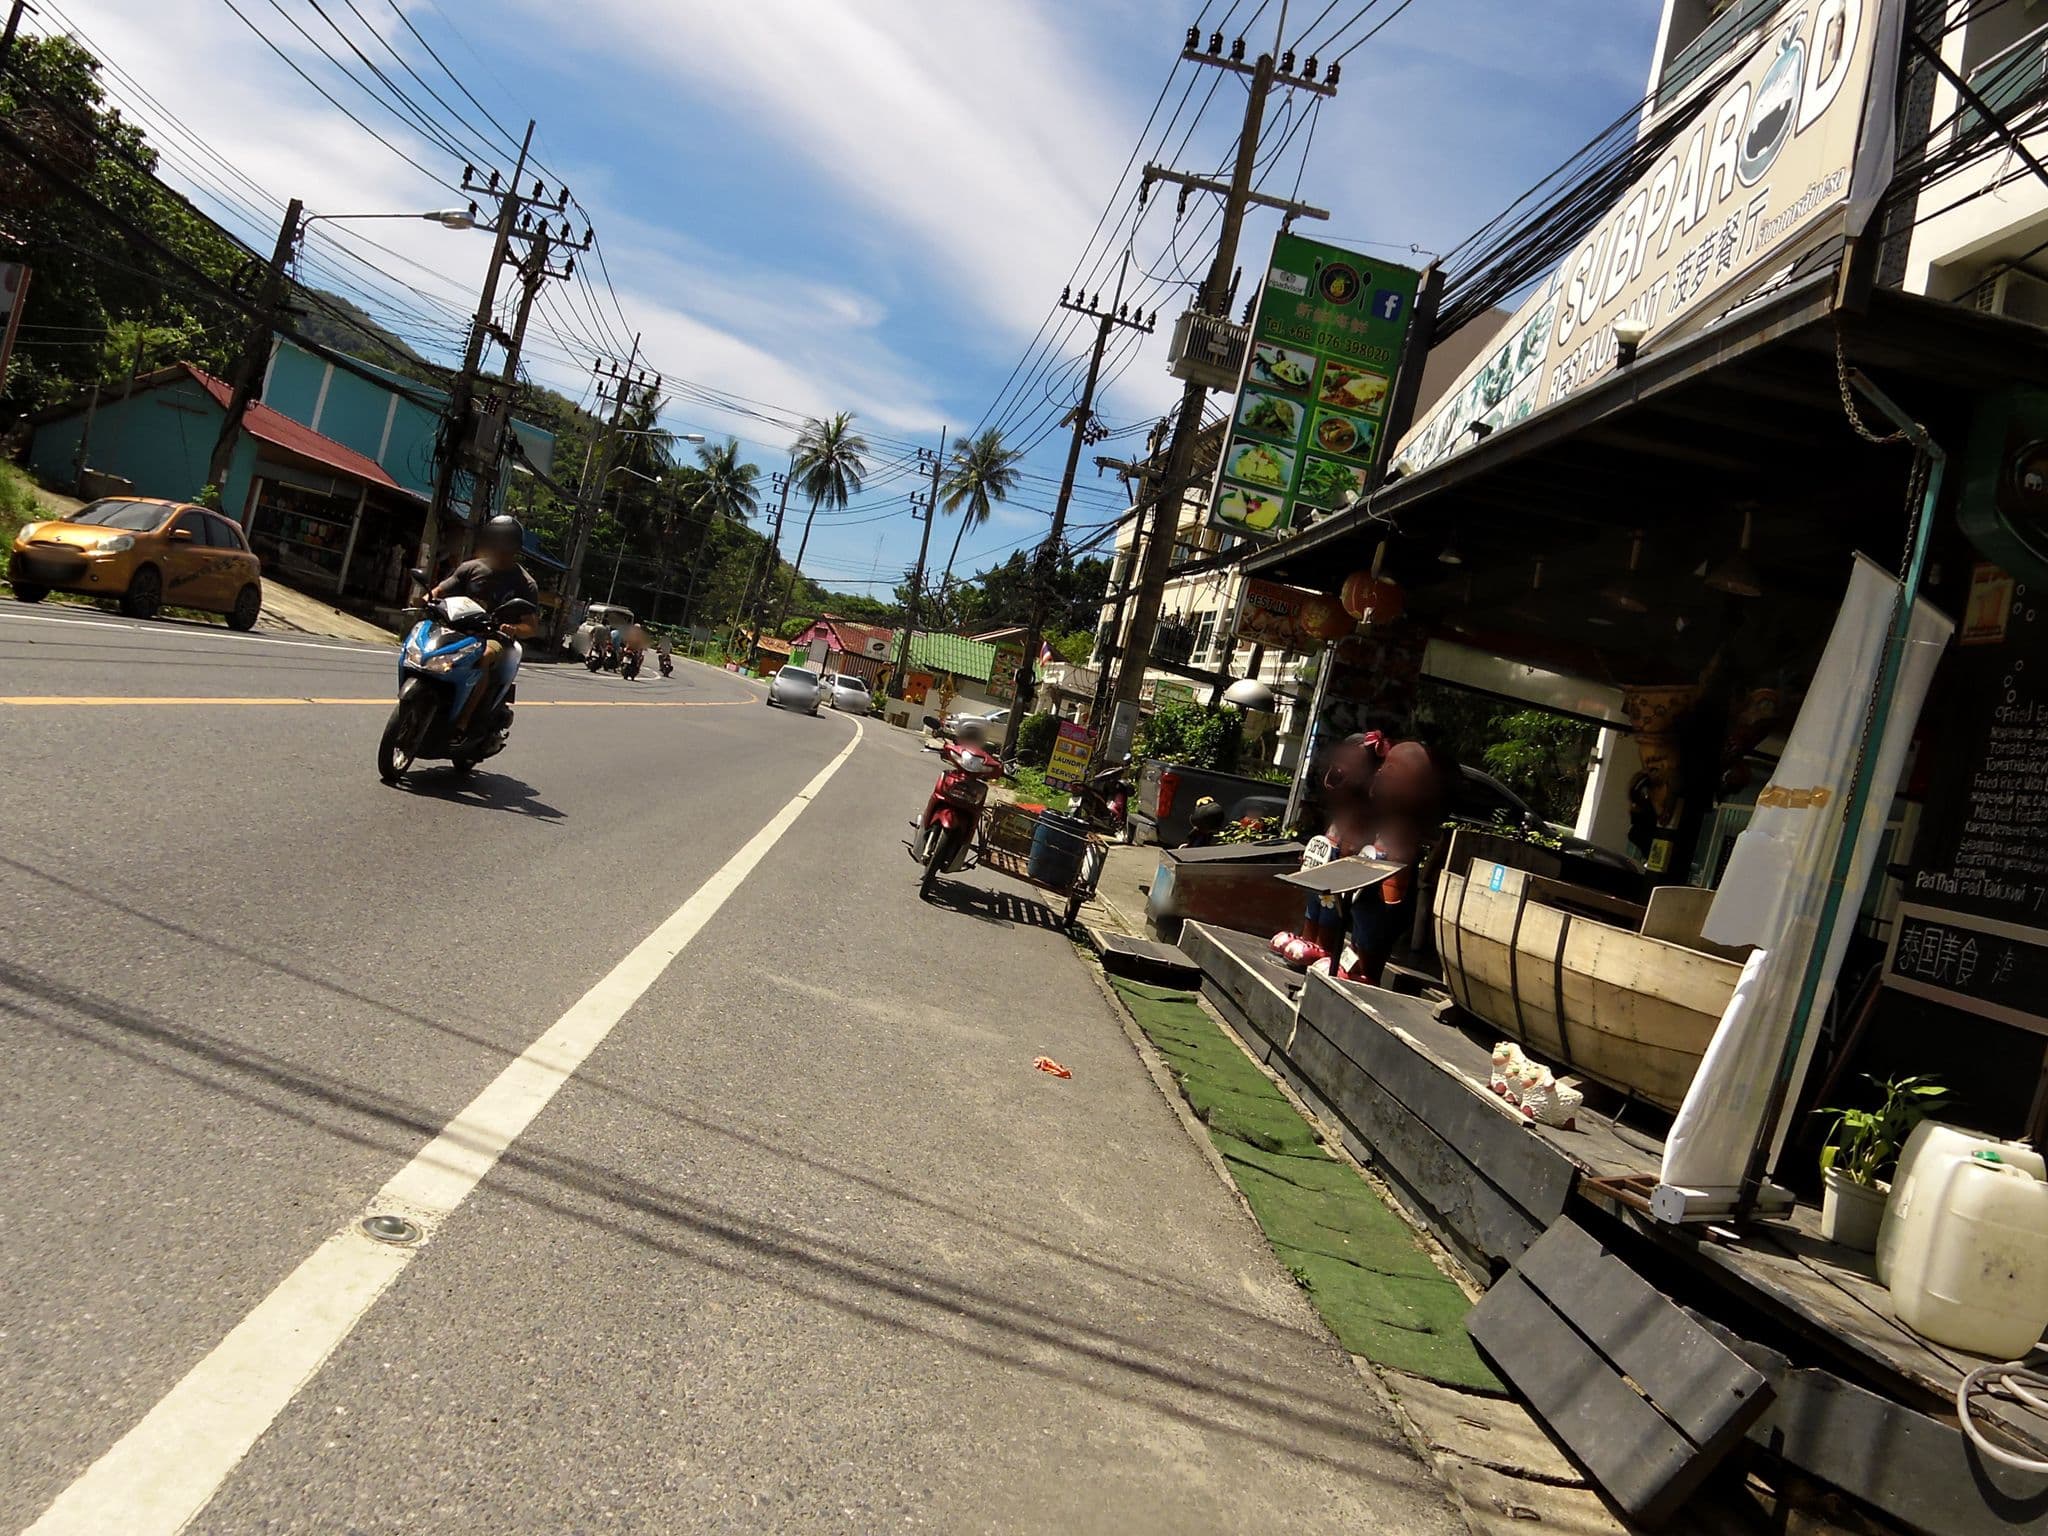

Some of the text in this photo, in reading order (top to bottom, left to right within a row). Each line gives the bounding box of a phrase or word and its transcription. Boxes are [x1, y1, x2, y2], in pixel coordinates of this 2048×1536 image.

[1289, 325, 1312, 340] +66
[1317, 331, 1340, 349] 076
[1345, 338, 1391, 363] 398020
[1053, 754, 1086, 768] LAUNDRY
[1051, 767, 1080, 781] SERVICE
